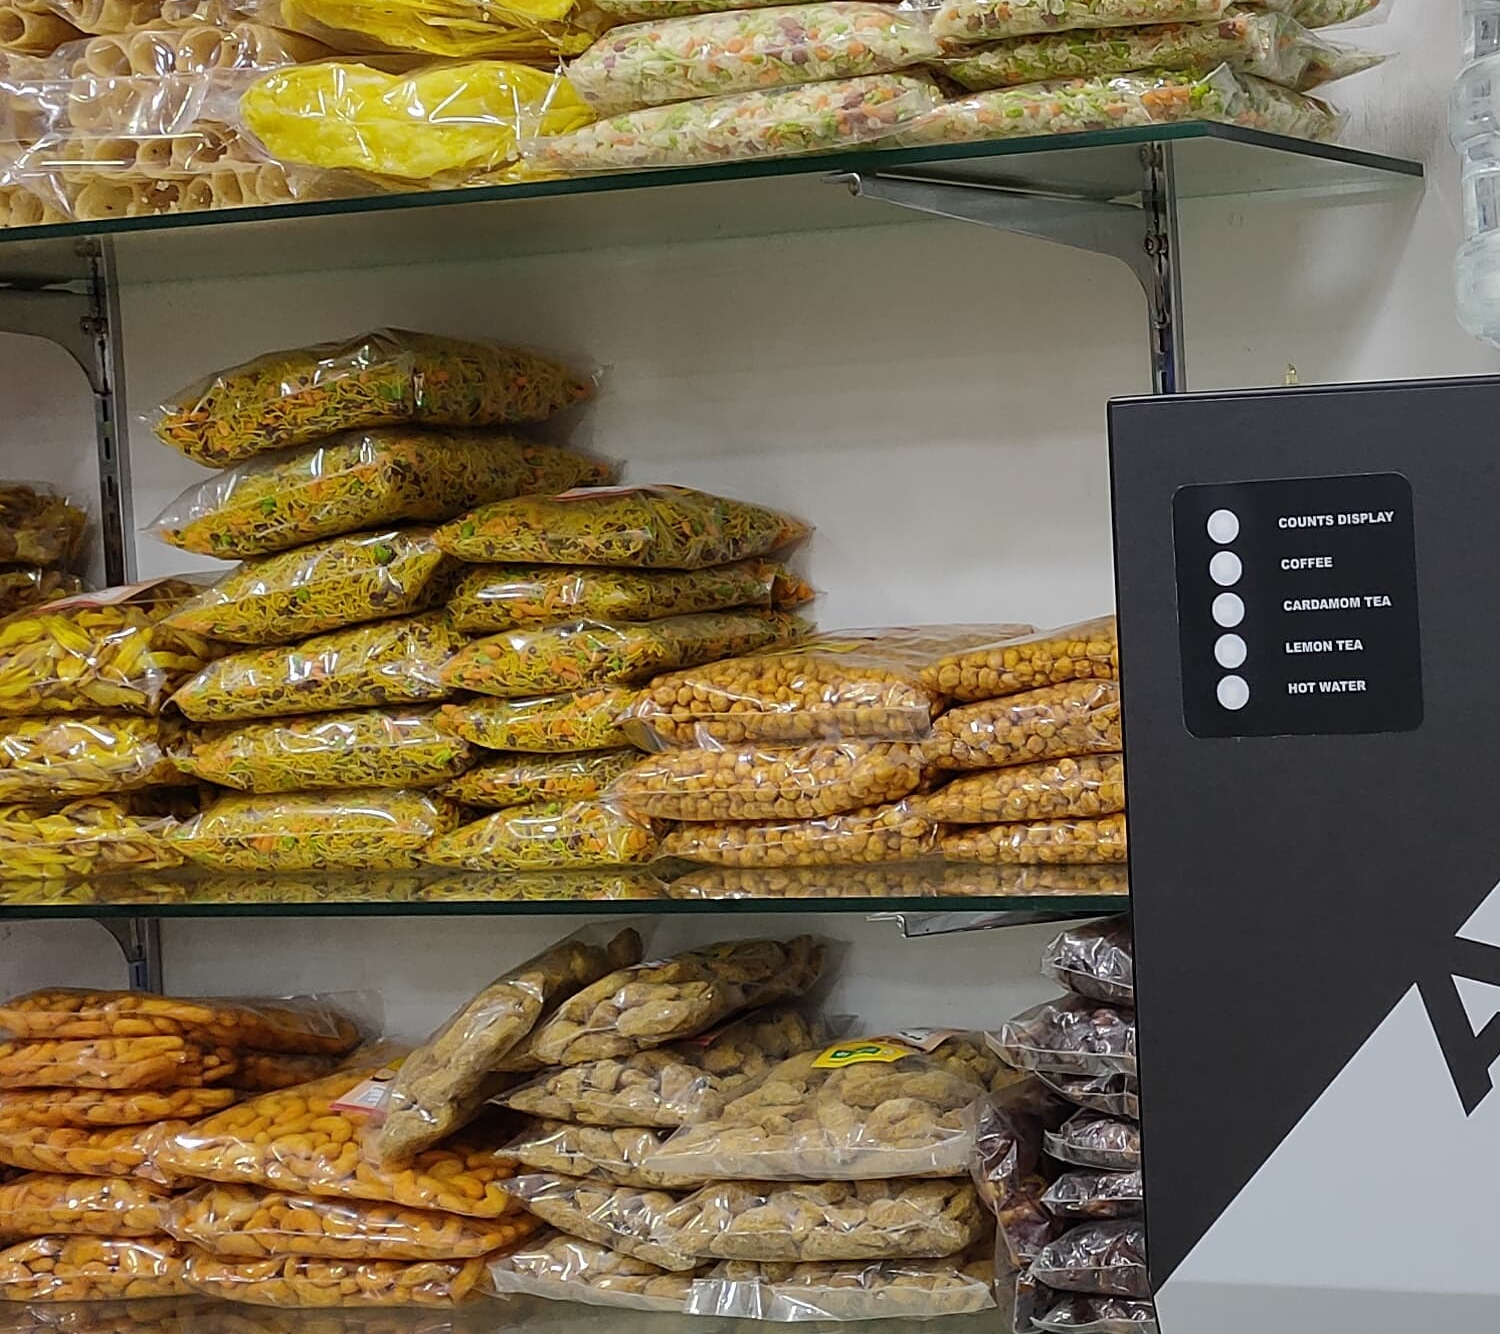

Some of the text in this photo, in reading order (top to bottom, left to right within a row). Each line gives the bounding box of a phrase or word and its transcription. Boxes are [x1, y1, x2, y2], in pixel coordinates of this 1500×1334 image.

[1278, 511, 1394, 529] COUNTS DISPLAY
[1281, 556, 1333, 570] COFFEE
[1283, 596, 1392, 611] CARDAMOM TEA
[1285, 639, 1364, 654] LEMON TEA
[1288, 680, 1366, 694] HOT WATER
